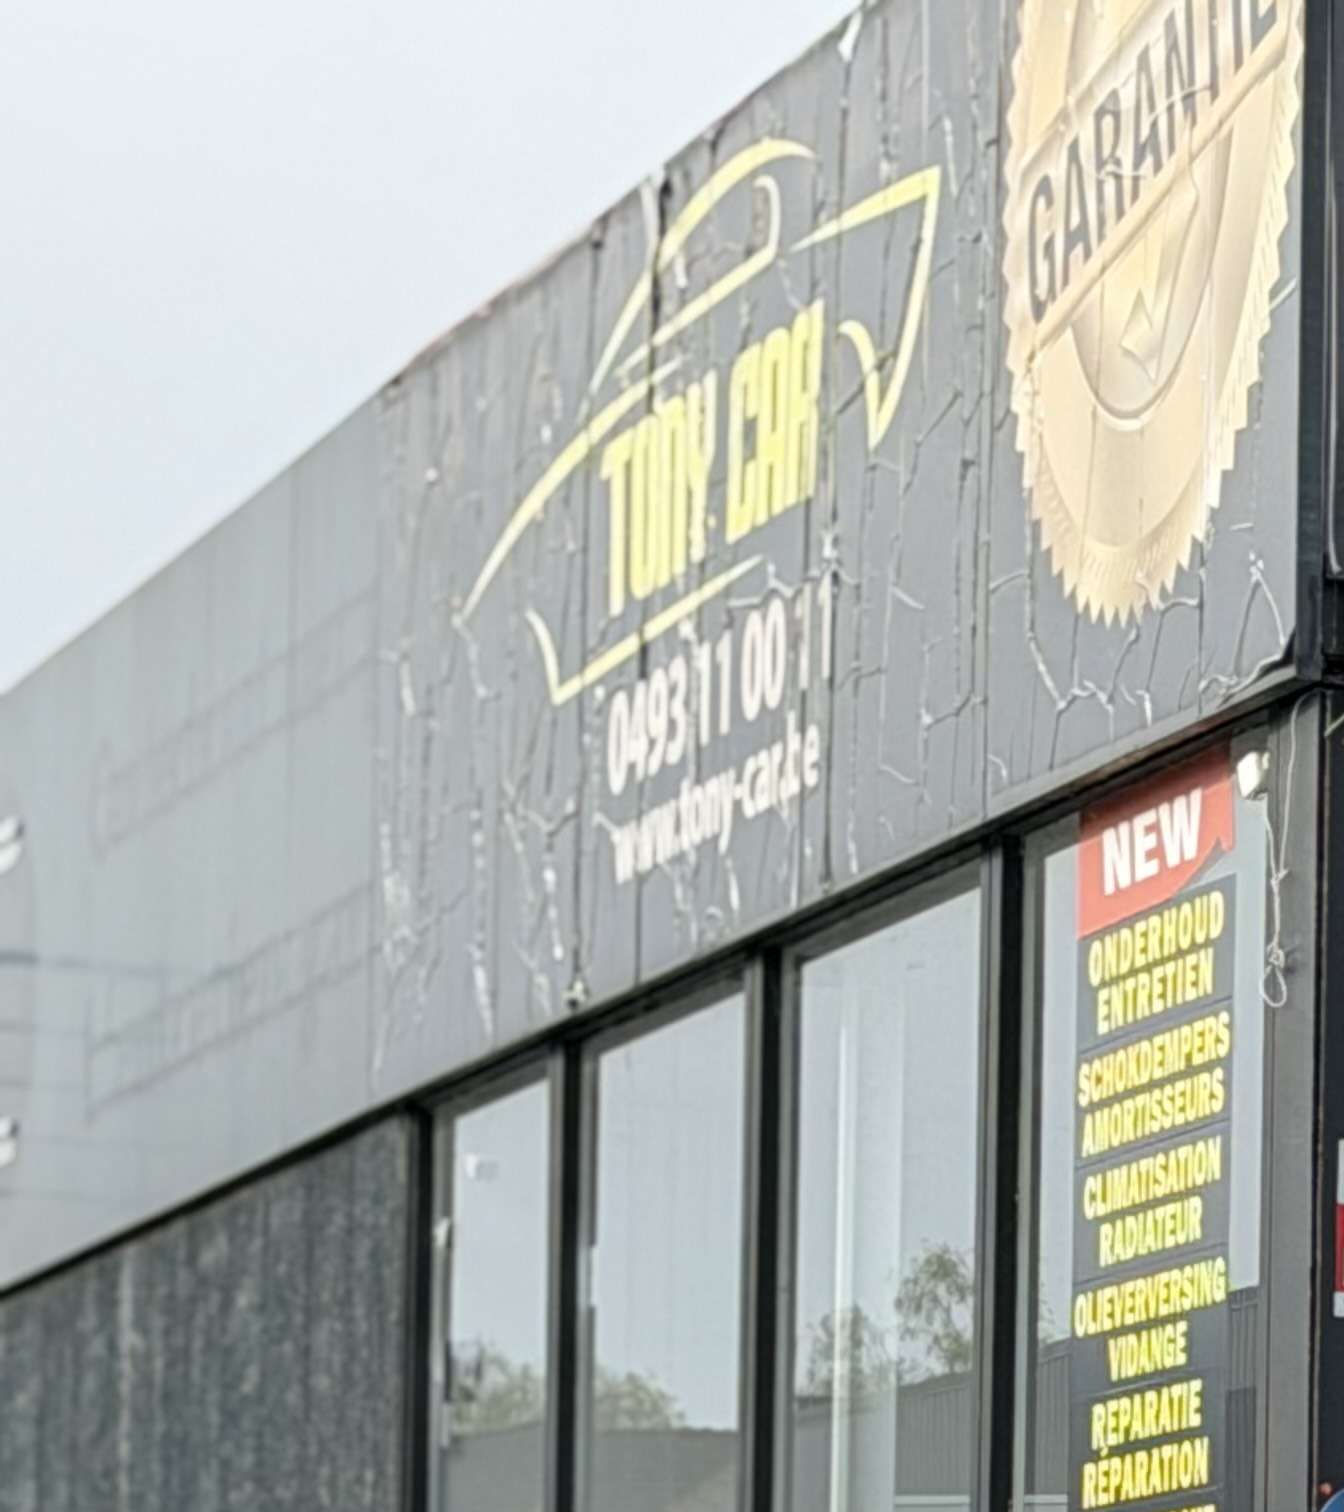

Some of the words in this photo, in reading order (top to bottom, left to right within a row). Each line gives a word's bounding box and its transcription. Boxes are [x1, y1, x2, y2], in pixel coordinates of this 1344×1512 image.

[600, 367, 718, 618] TONY
[724, 298, 825, 545] CAR
[607, 655, 687, 797] 0493
[741, 598, 787, 722] 00
[1101, 789, 1204, 897] NEW
[1087, 890, 1226, 988] ONDERHOUD
[1096, 946, 1214, 1036] ENTRETIEN
[1077, 1010, 1231, 1107] SCHOKDEMPERS
[1081, 1066, 1225, 1158] AMORTISSEURS
[1083, 1135, 1222, 1220] CLIMATISATION
[1099, 1195, 1203, 1268] RADIATEUR
[1073, 1256, 1227, 1339] OLIEVERVERSING
[1108, 1320, 1189, 1382] VIDANGE
[1091, 1378, 1203, 1451] REPARATIE
